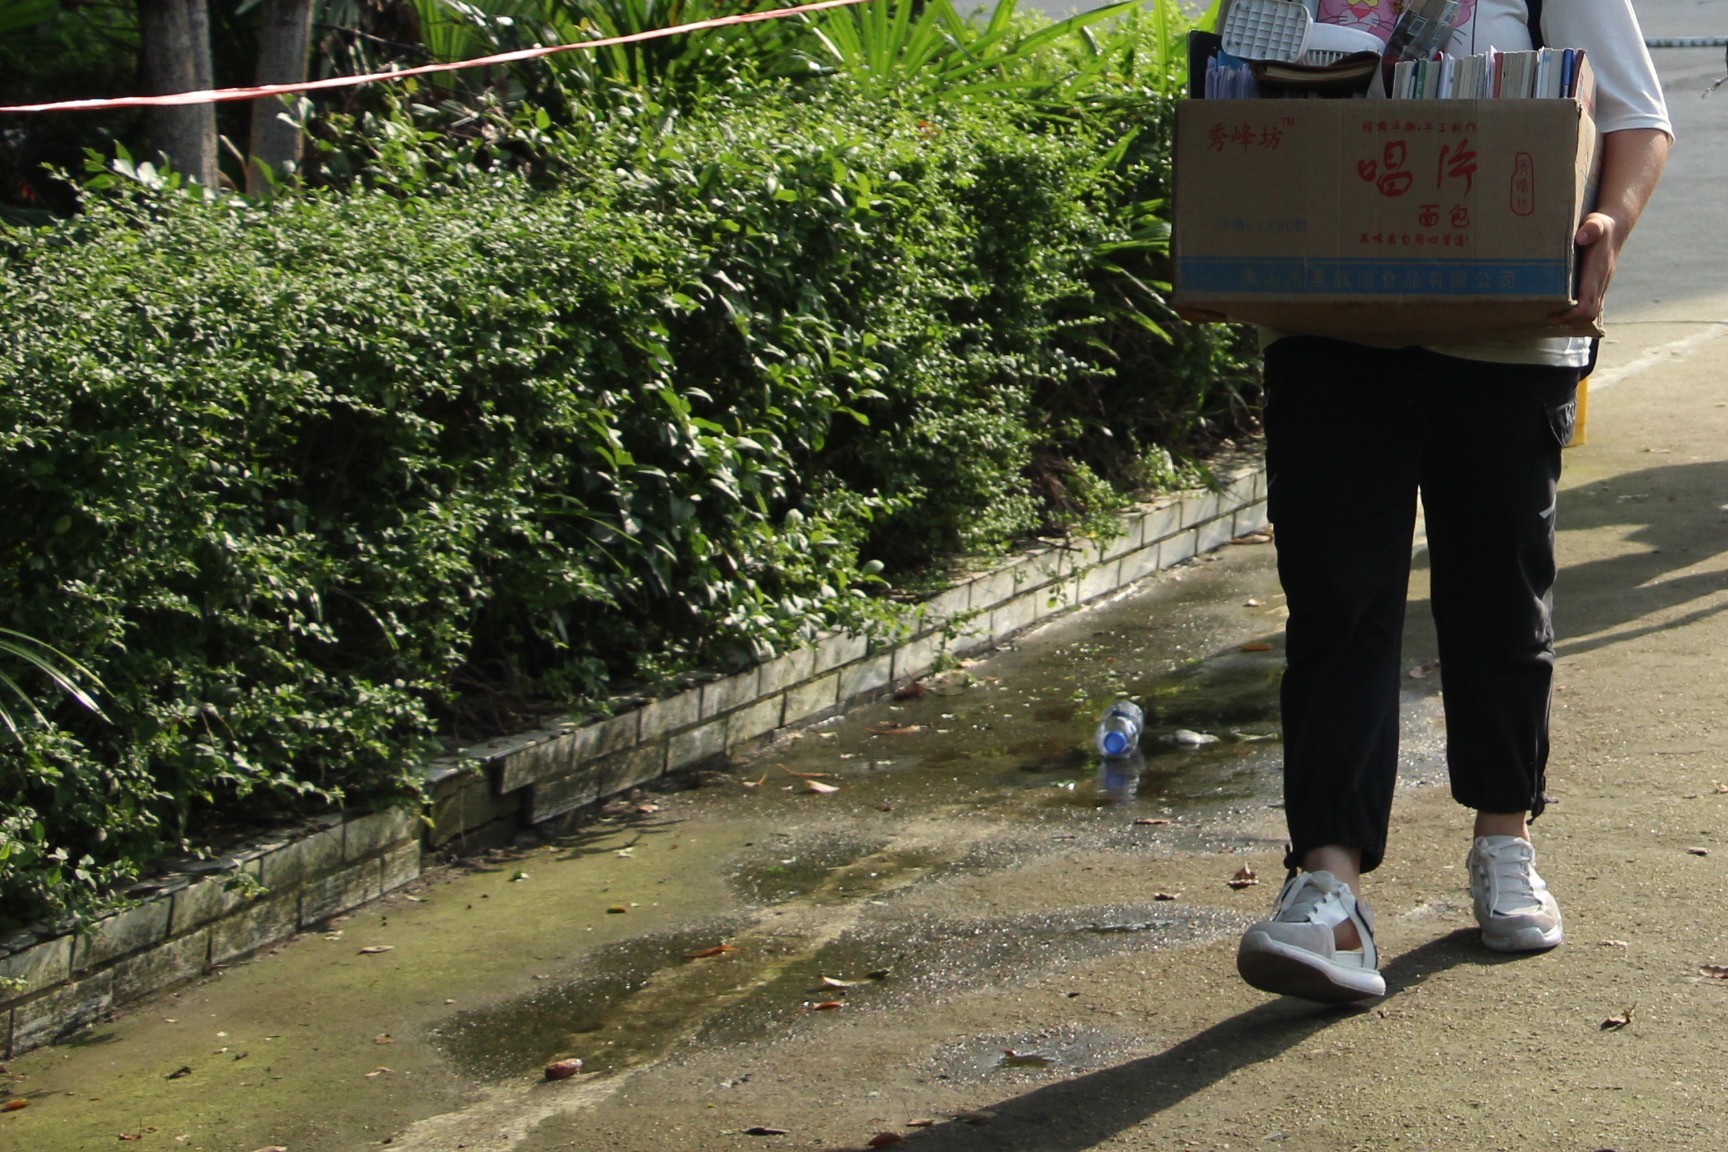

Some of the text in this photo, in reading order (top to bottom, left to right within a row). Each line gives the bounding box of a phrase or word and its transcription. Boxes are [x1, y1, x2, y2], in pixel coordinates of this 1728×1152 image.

[1207, 121, 1284, 152] 秀峰坊
[1357, 138, 1478, 198] 唱片
[1418, 204, 1470, 229] 面包
